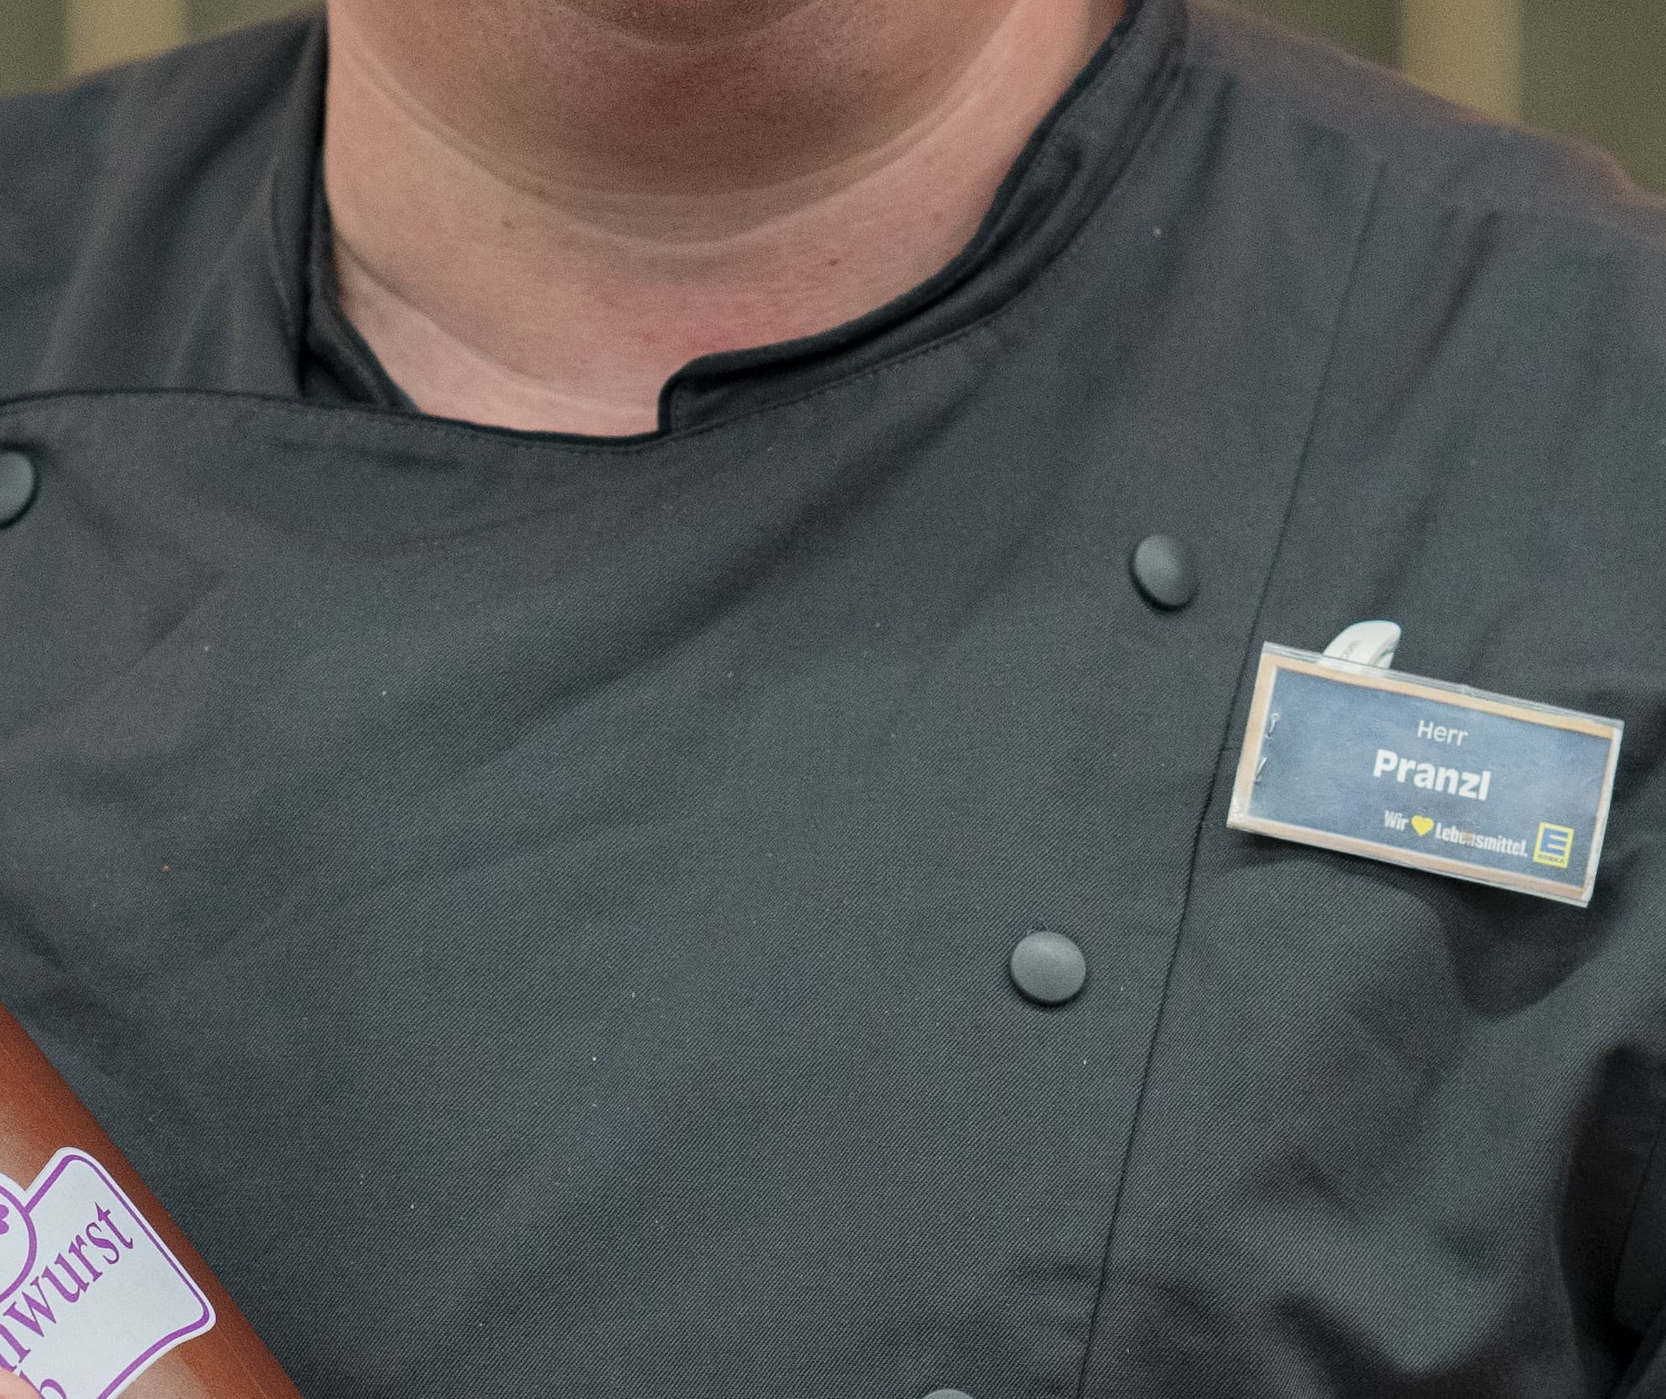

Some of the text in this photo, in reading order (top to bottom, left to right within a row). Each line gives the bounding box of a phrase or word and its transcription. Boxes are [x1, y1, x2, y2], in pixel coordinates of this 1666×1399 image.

[1417, 719, 1469, 746] Herr
[1373, 748, 1491, 801] Pranzl
[1384, 810, 1409, 831] Wir
